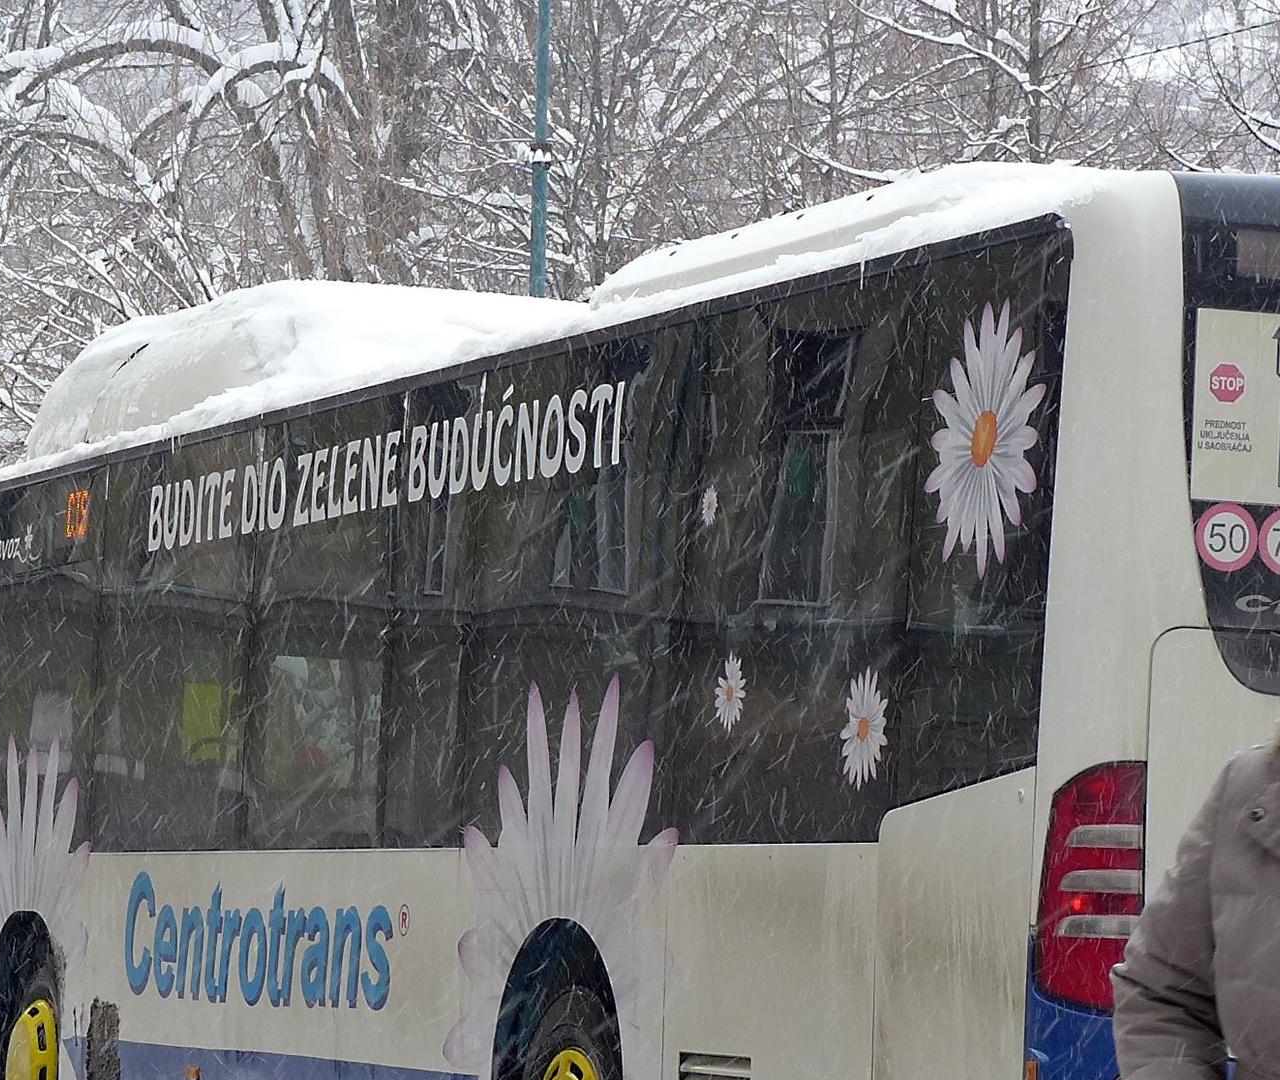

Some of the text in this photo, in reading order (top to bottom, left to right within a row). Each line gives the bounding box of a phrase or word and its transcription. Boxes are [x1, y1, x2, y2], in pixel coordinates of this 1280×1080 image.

[1211, 374, 1245, 392] STOP
[1204, 419, 1247, 430] PREDNOST
[1197, 441, 1203, 449] U
[148, 380, 626, 552] BUDITE DIO ZELENE BUDUĆNOSTI
[1209, 523, 1247, 554] 50
